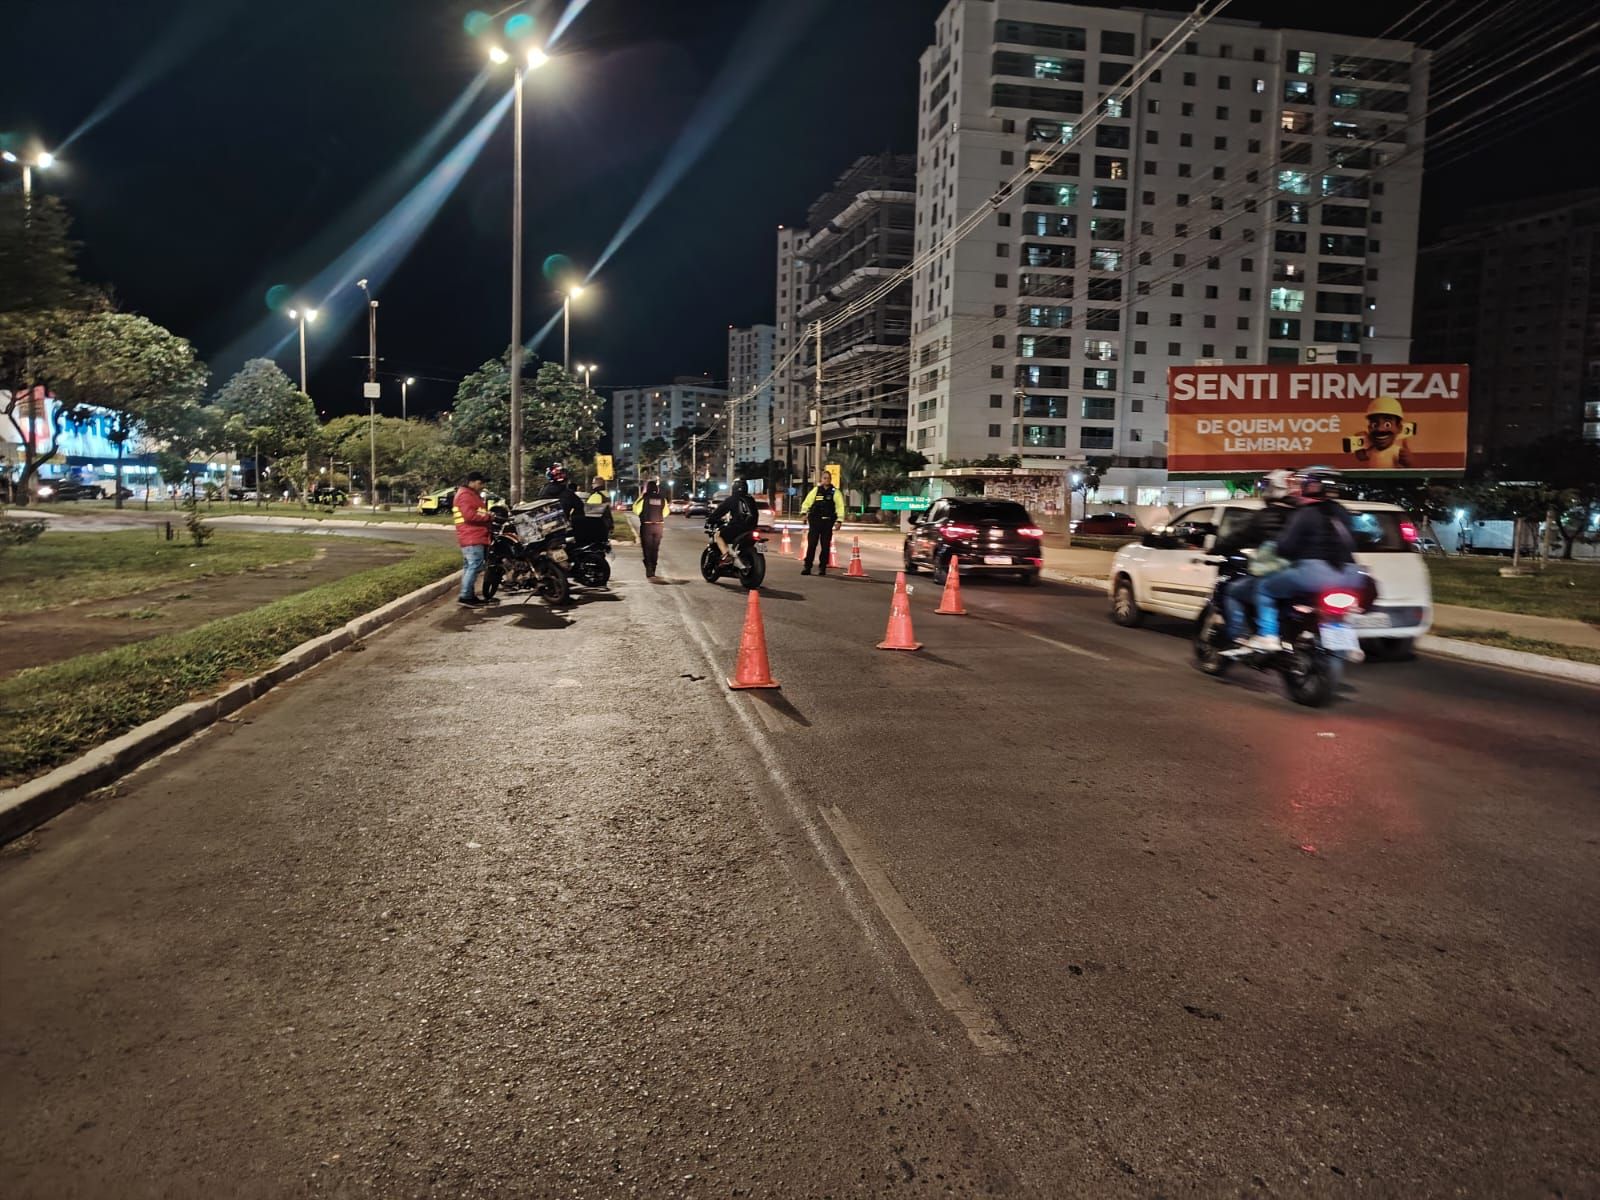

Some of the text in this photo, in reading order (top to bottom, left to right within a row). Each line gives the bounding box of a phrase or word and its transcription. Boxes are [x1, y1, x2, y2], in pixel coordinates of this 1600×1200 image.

[1173, 372, 1461, 401] SENTI FIRMEZA!
[1196, 415, 1341, 436] DE QUEM VOCÊ
[1224, 437, 1313, 452] LEMBRA?
